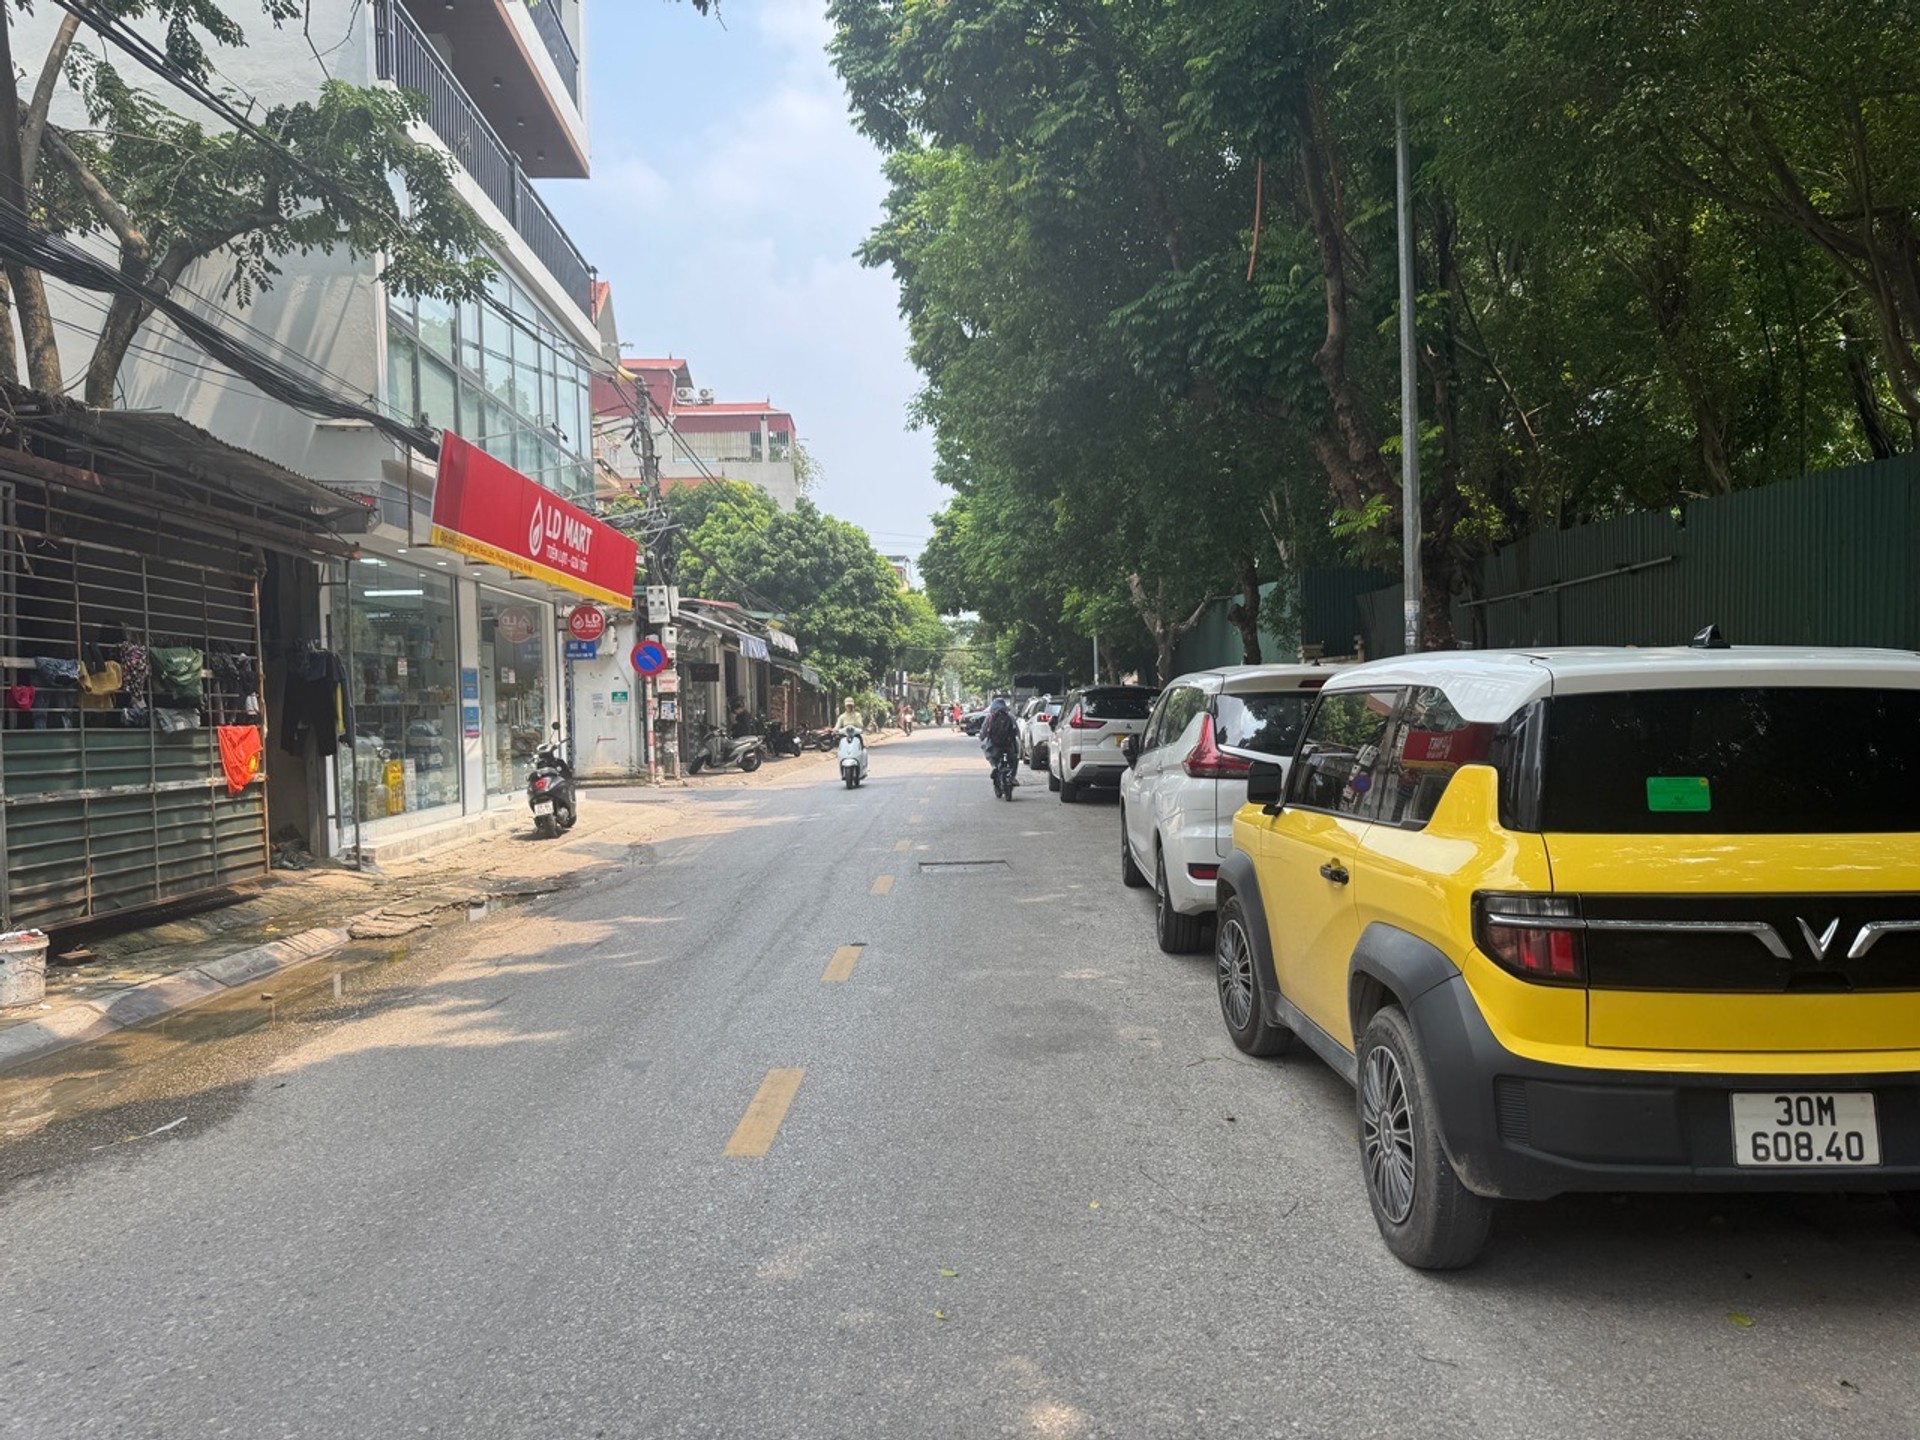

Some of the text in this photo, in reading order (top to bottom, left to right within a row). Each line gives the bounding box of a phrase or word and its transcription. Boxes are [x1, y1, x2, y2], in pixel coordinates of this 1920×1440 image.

[545, 505, 562, 540] LD
[562, 514, 593, 555] MART
[584, 613, 601, 624] LD
[1774, 1096, 1836, 1126] 30M
[1751, 1131, 1864, 1162] 608.40
